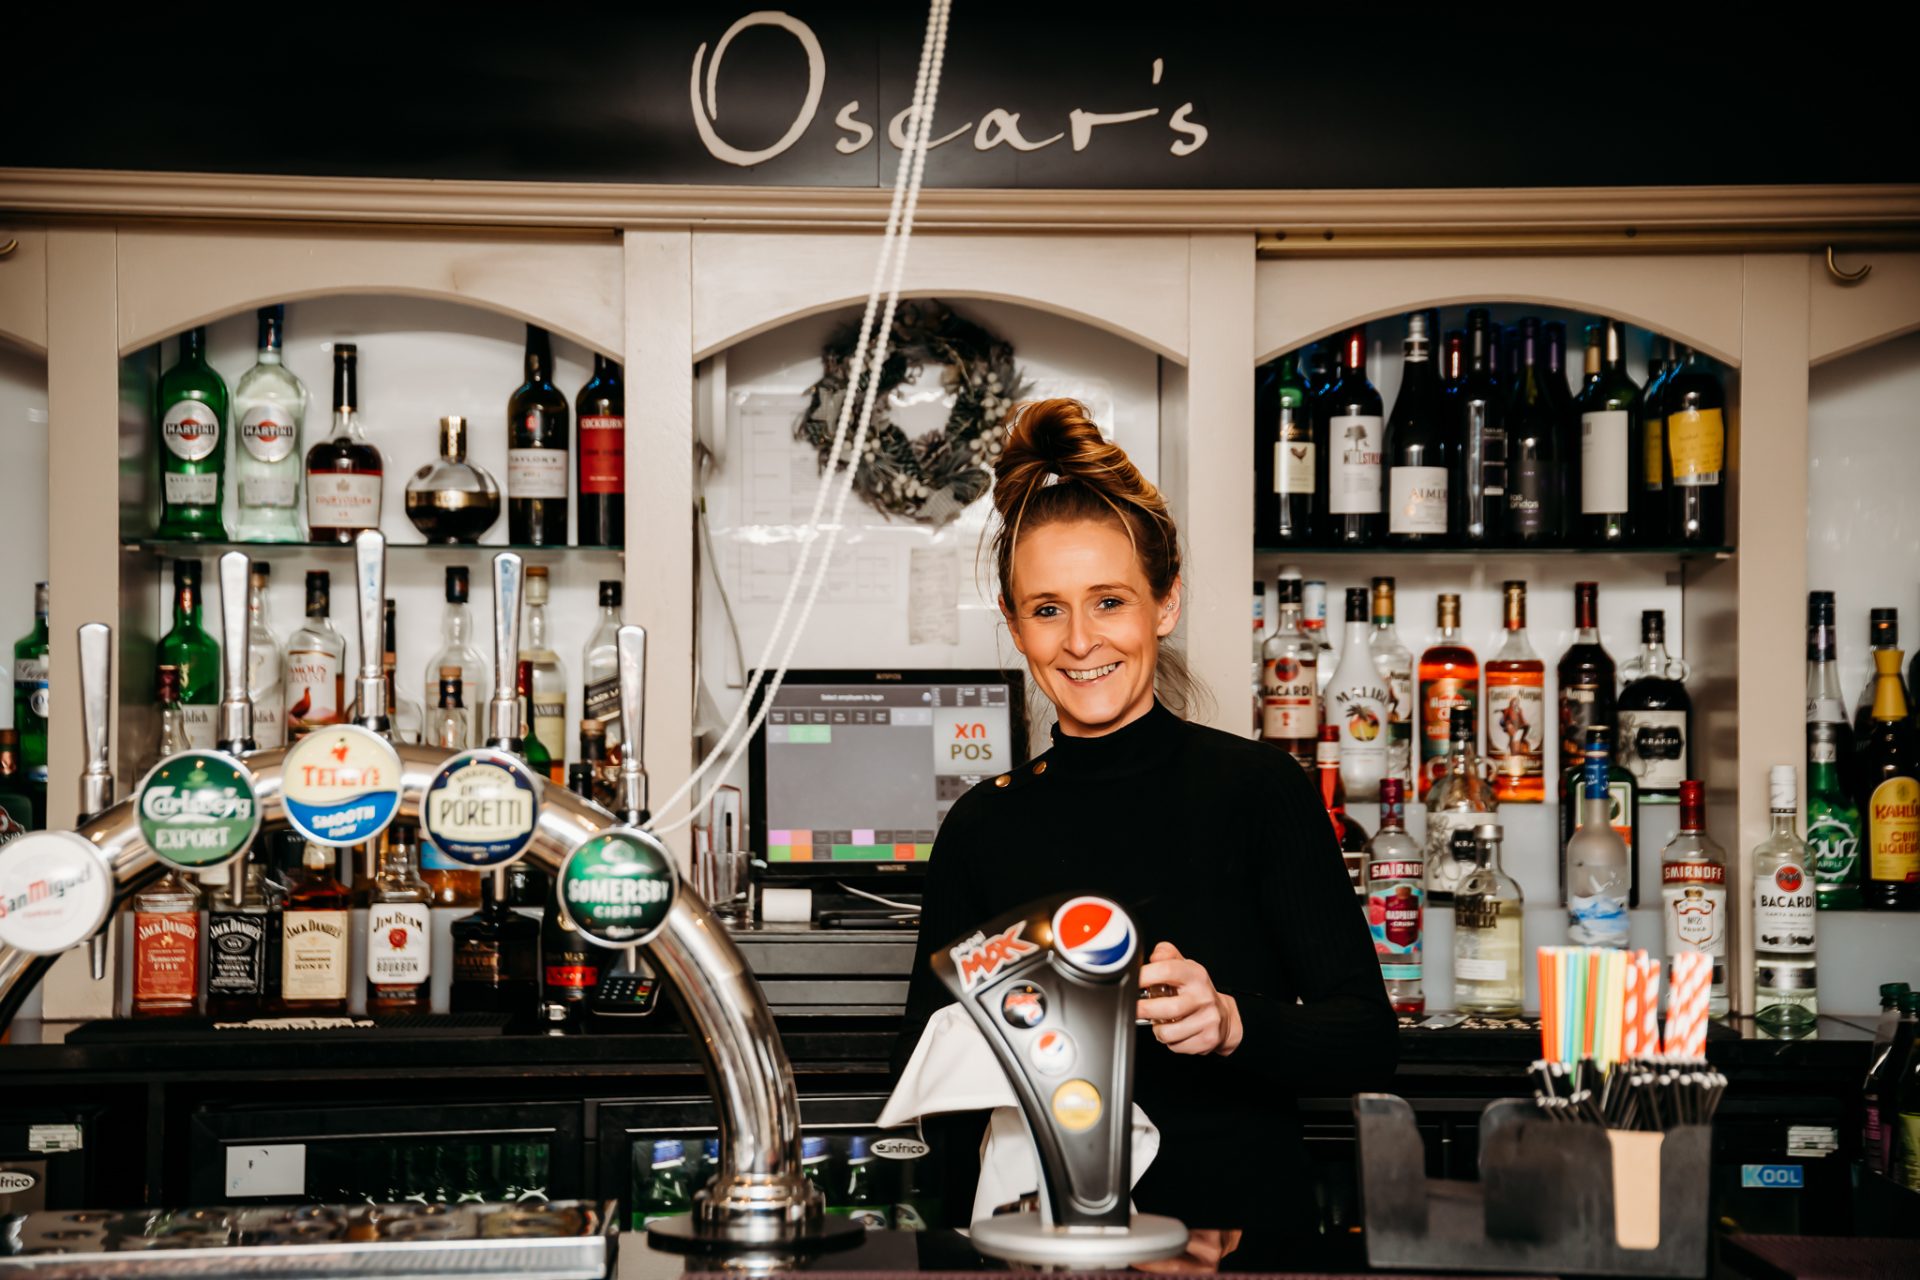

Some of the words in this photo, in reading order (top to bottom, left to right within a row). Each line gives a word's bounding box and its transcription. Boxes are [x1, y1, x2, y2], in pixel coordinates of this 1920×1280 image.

[690, 10, 1209, 167] Oscar's
[165, 424, 216, 435] MARTINI
[243, 425, 294, 437] MARTINI
[951, 744, 993, 760] POS
[440, 800, 522, 826] PORETTI
[156, 827, 231, 849] EXPORT
[1664, 866, 1722, 880] SMIRNOFF
[568, 878, 669, 904] SOMERSBY
[593, 905, 642, 918] CIDER
[373, 917, 392, 933] JIM
[377, 962, 418, 972] BOURBON
[888, 1143, 925, 1153] infrico
[1743, 1165, 1801, 1187] KOOL
